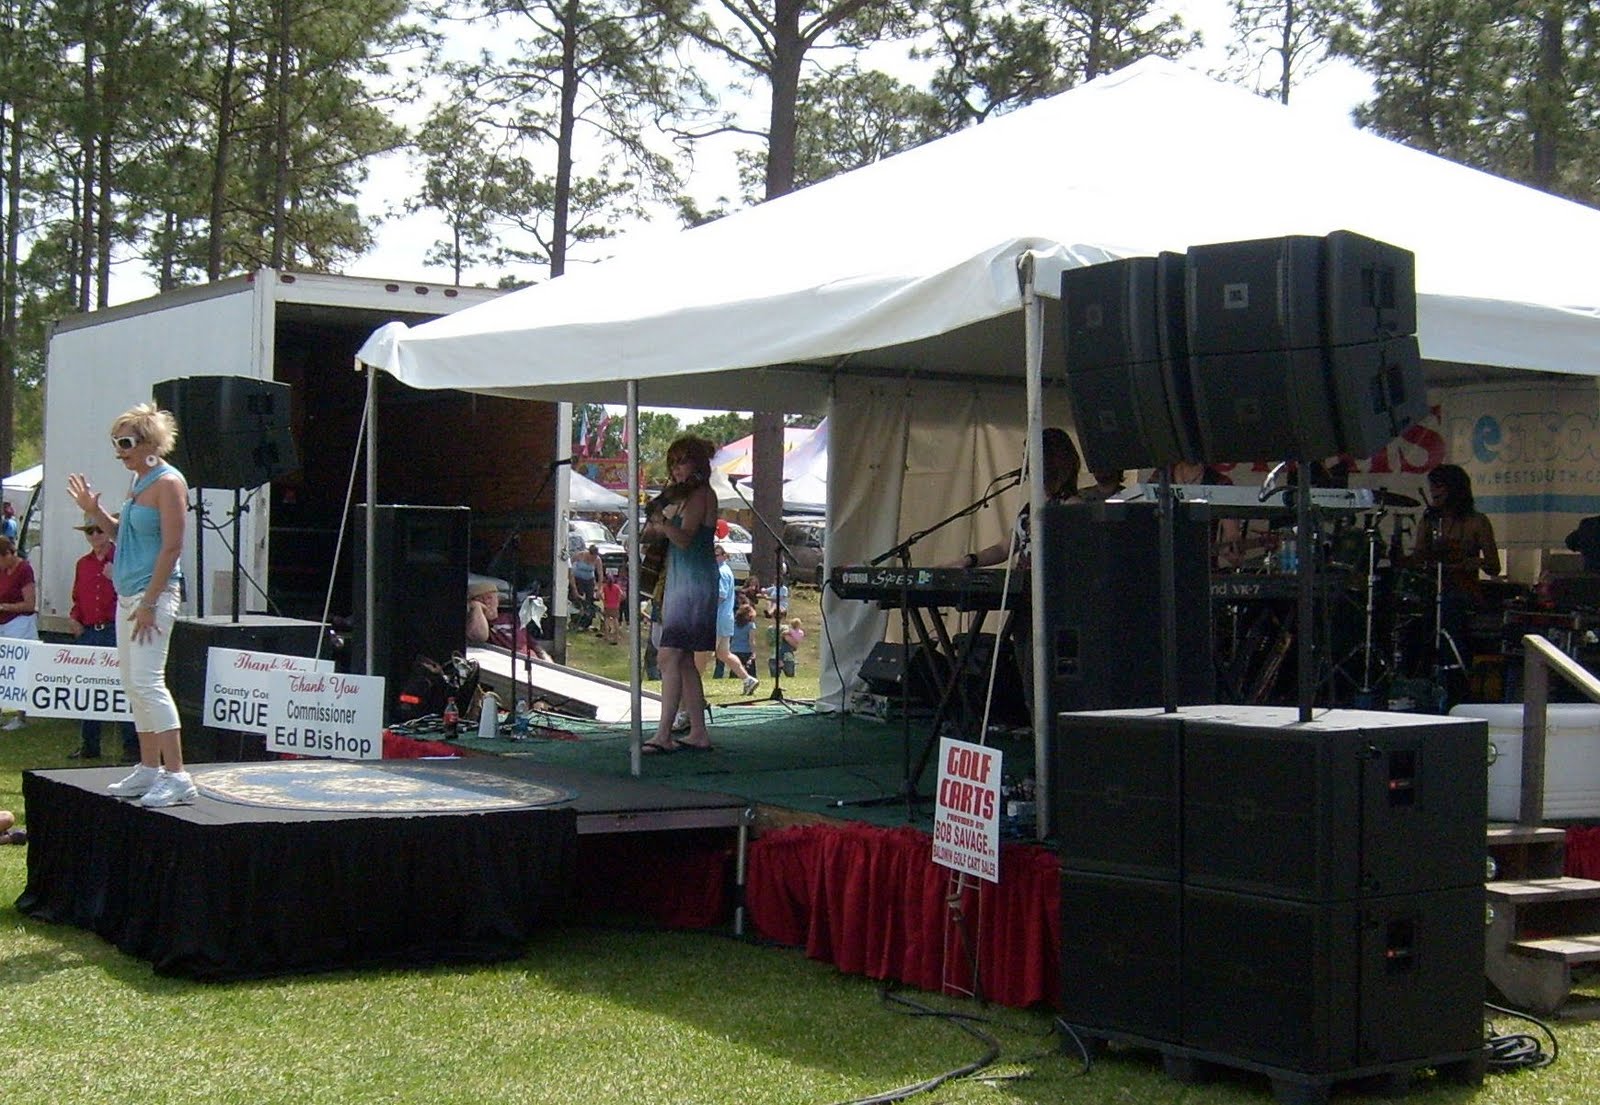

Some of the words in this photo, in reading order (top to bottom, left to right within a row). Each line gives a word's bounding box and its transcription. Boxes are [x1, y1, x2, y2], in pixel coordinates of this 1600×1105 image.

[53, 648, 97, 666] Thank
[35, 672, 73, 685] County
[213, 684, 250, 699] County
[288, 674, 326, 694] Thank
[329, 676, 360, 700] You
[31, 685, 134, 714] GRUBE
[287, 699, 357, 725] Commissioner
[275, 726, 297, 747] Ed
[304, 728, 372, 758] Bishop
[946, 746, 992, 784] GOLF
[939, 778, 995, 821] CARTS
[935, 819, 952, 843] BOB
[953, 825, 988, 856] SAVAGE
[967, 856, 981, 872] CART
